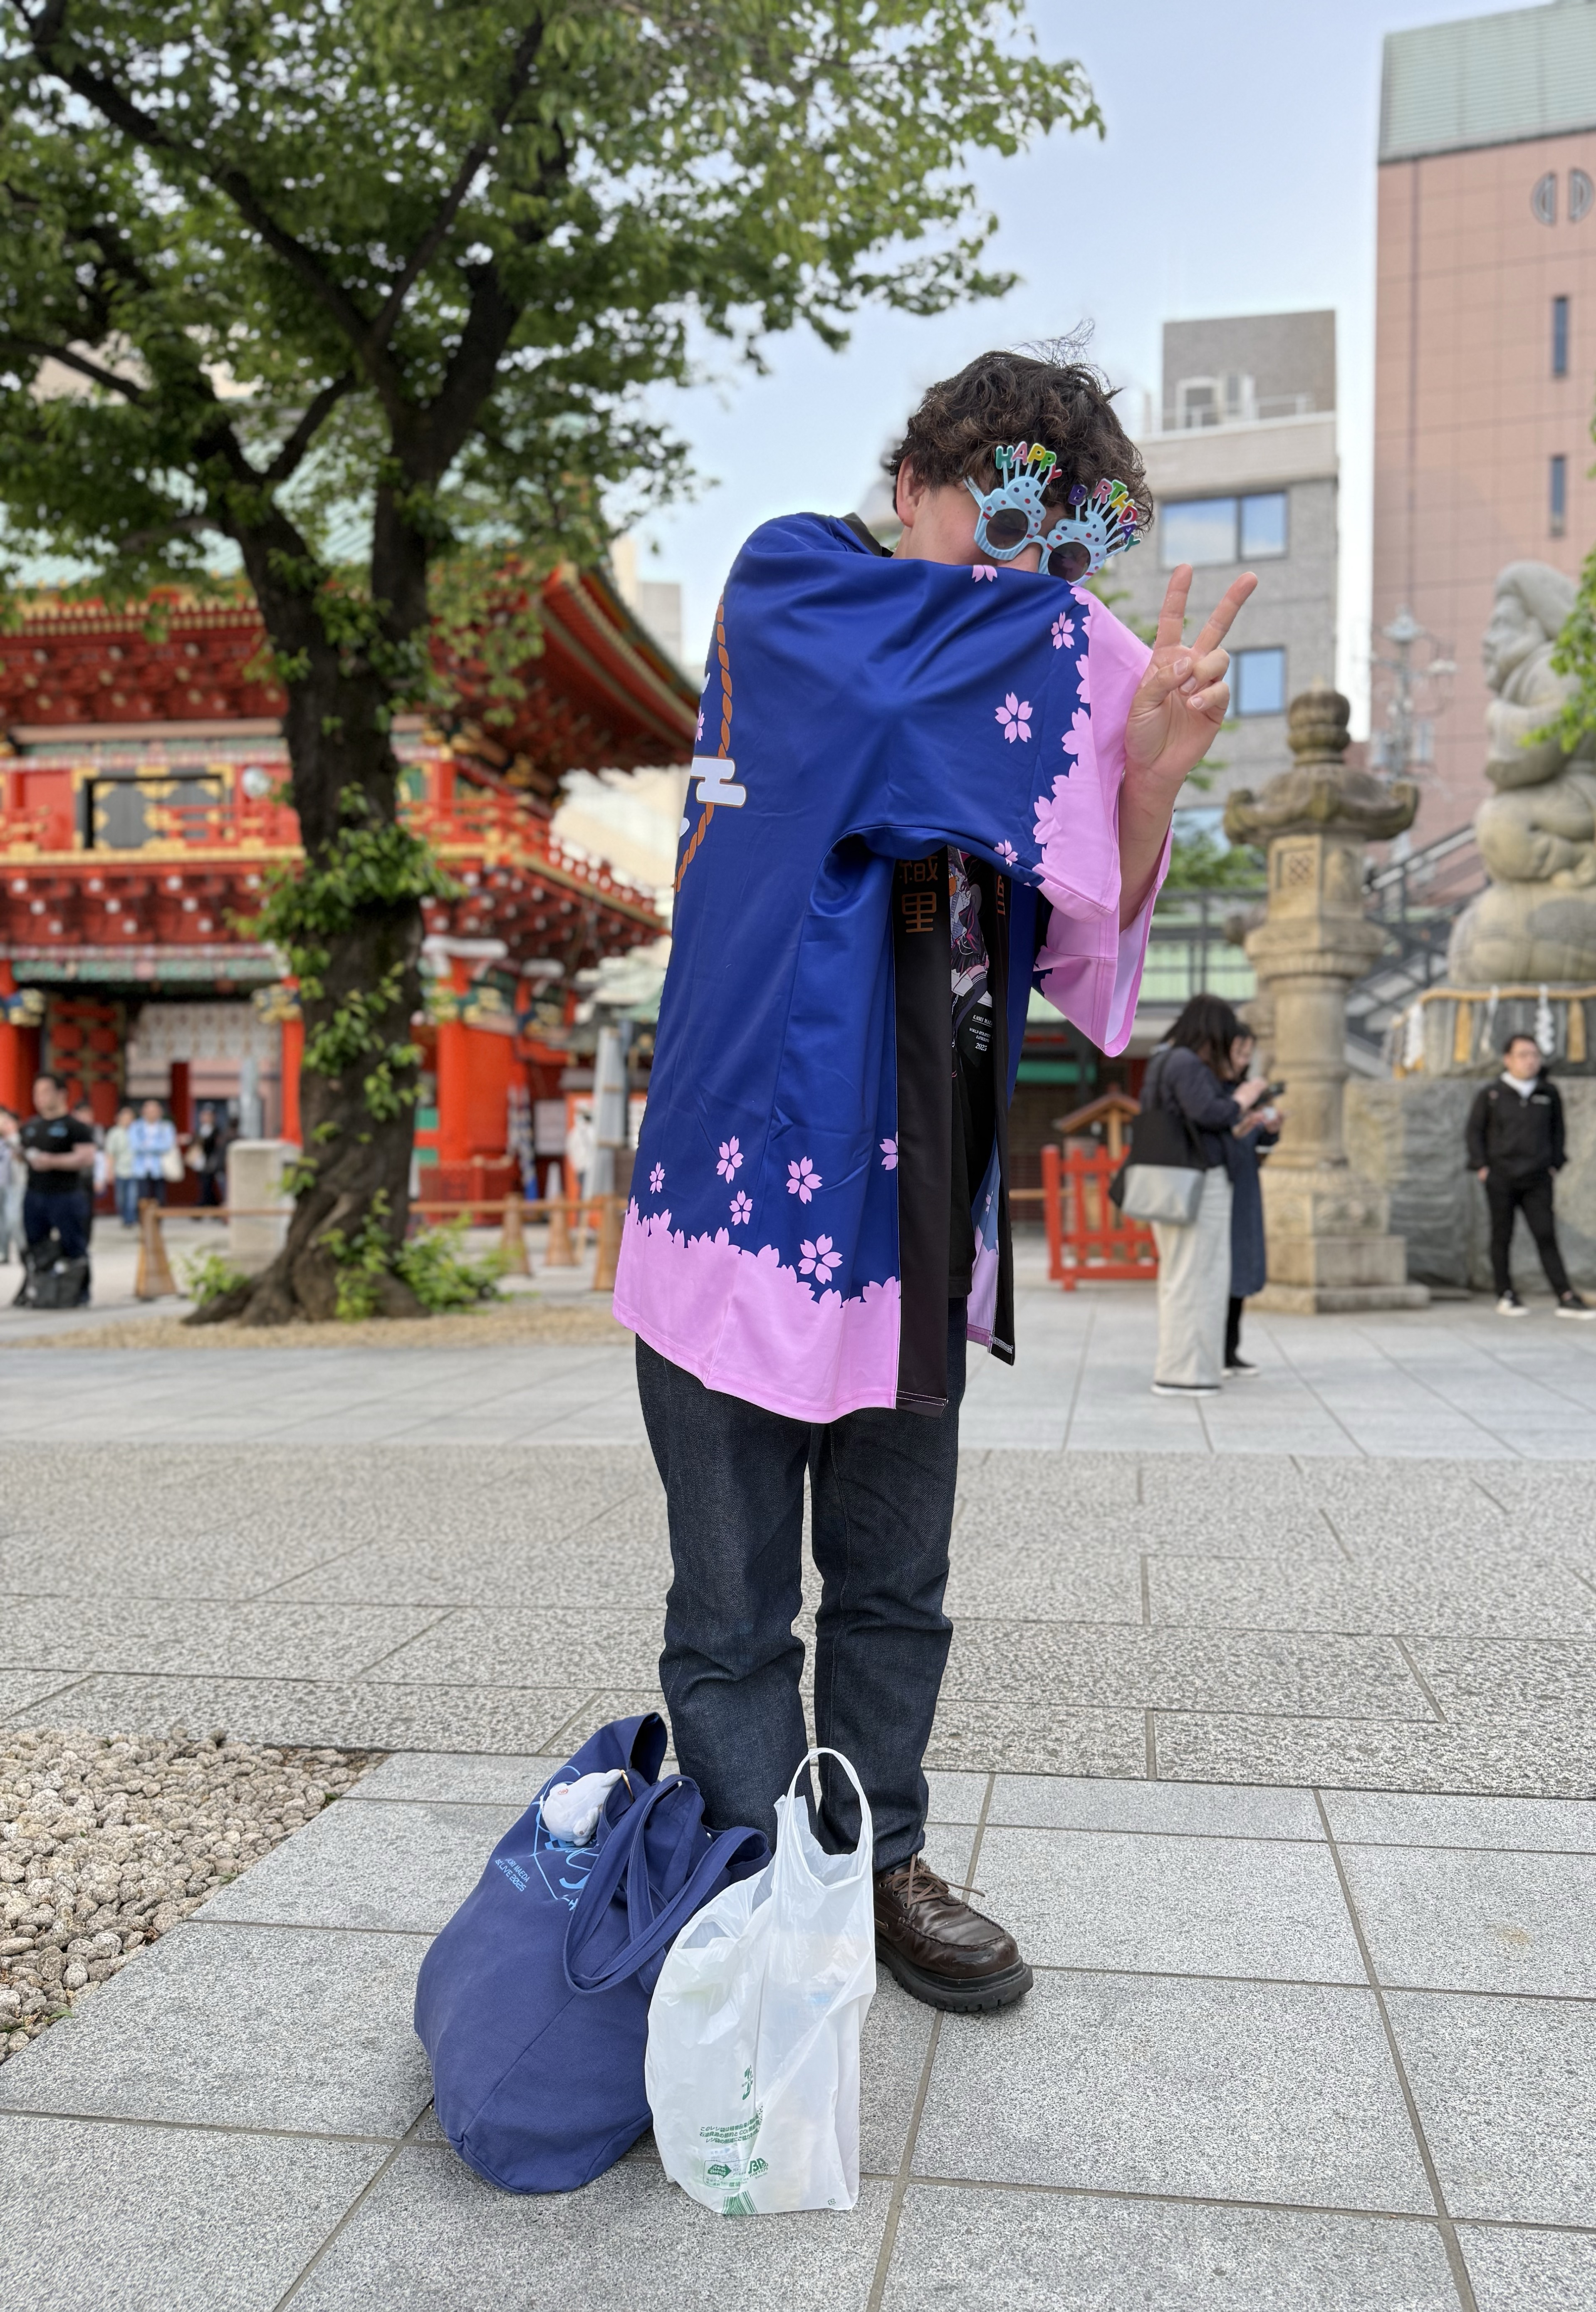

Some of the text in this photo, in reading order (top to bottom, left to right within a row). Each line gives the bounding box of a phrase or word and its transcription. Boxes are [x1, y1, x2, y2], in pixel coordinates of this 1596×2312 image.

[996, 441, 1062, 485] HAPPY
[1068, 478, 1141, 552] BRTHDAY
[975, 1043, 987, 1051] 2025
[499, 1862, 513, 1877] LIVE
[509, 1874, 526, 1892] 2025
[513, 1865, 530, 1882] MAEDA
